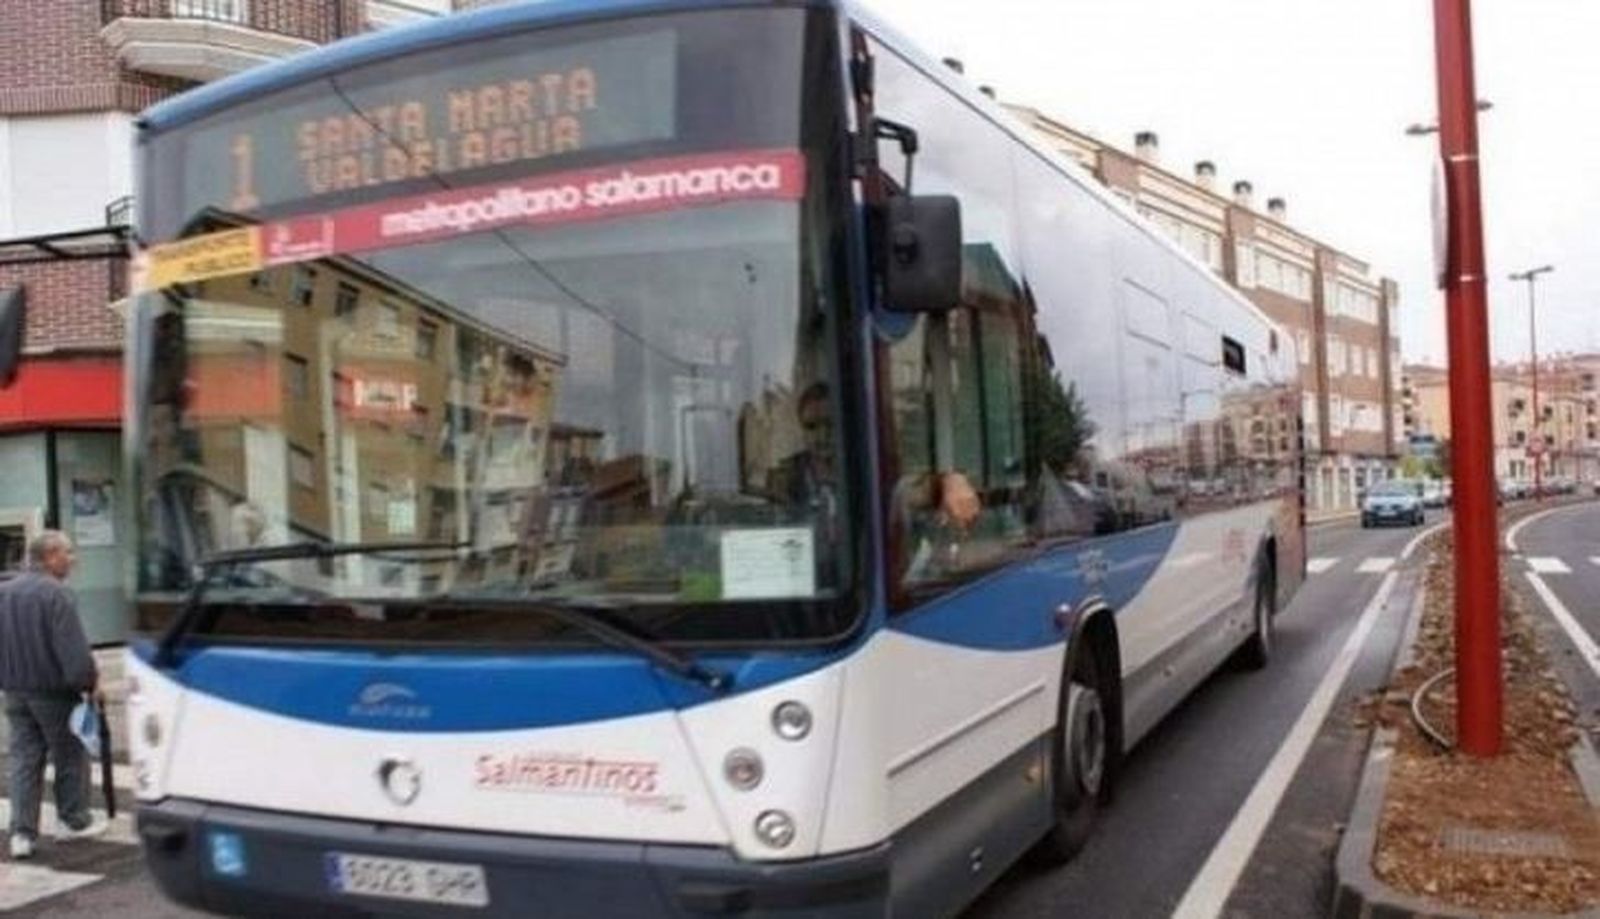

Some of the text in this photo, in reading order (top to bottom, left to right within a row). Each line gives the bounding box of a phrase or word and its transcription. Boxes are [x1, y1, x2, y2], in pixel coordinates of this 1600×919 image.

[297, 68, 597, 161] SANTA MARTA
[230, 134, 259, 212] 1
[381, 163, 781, 237] metropolitano salamanca
[475, 754, 659, 794] Salmantinos
